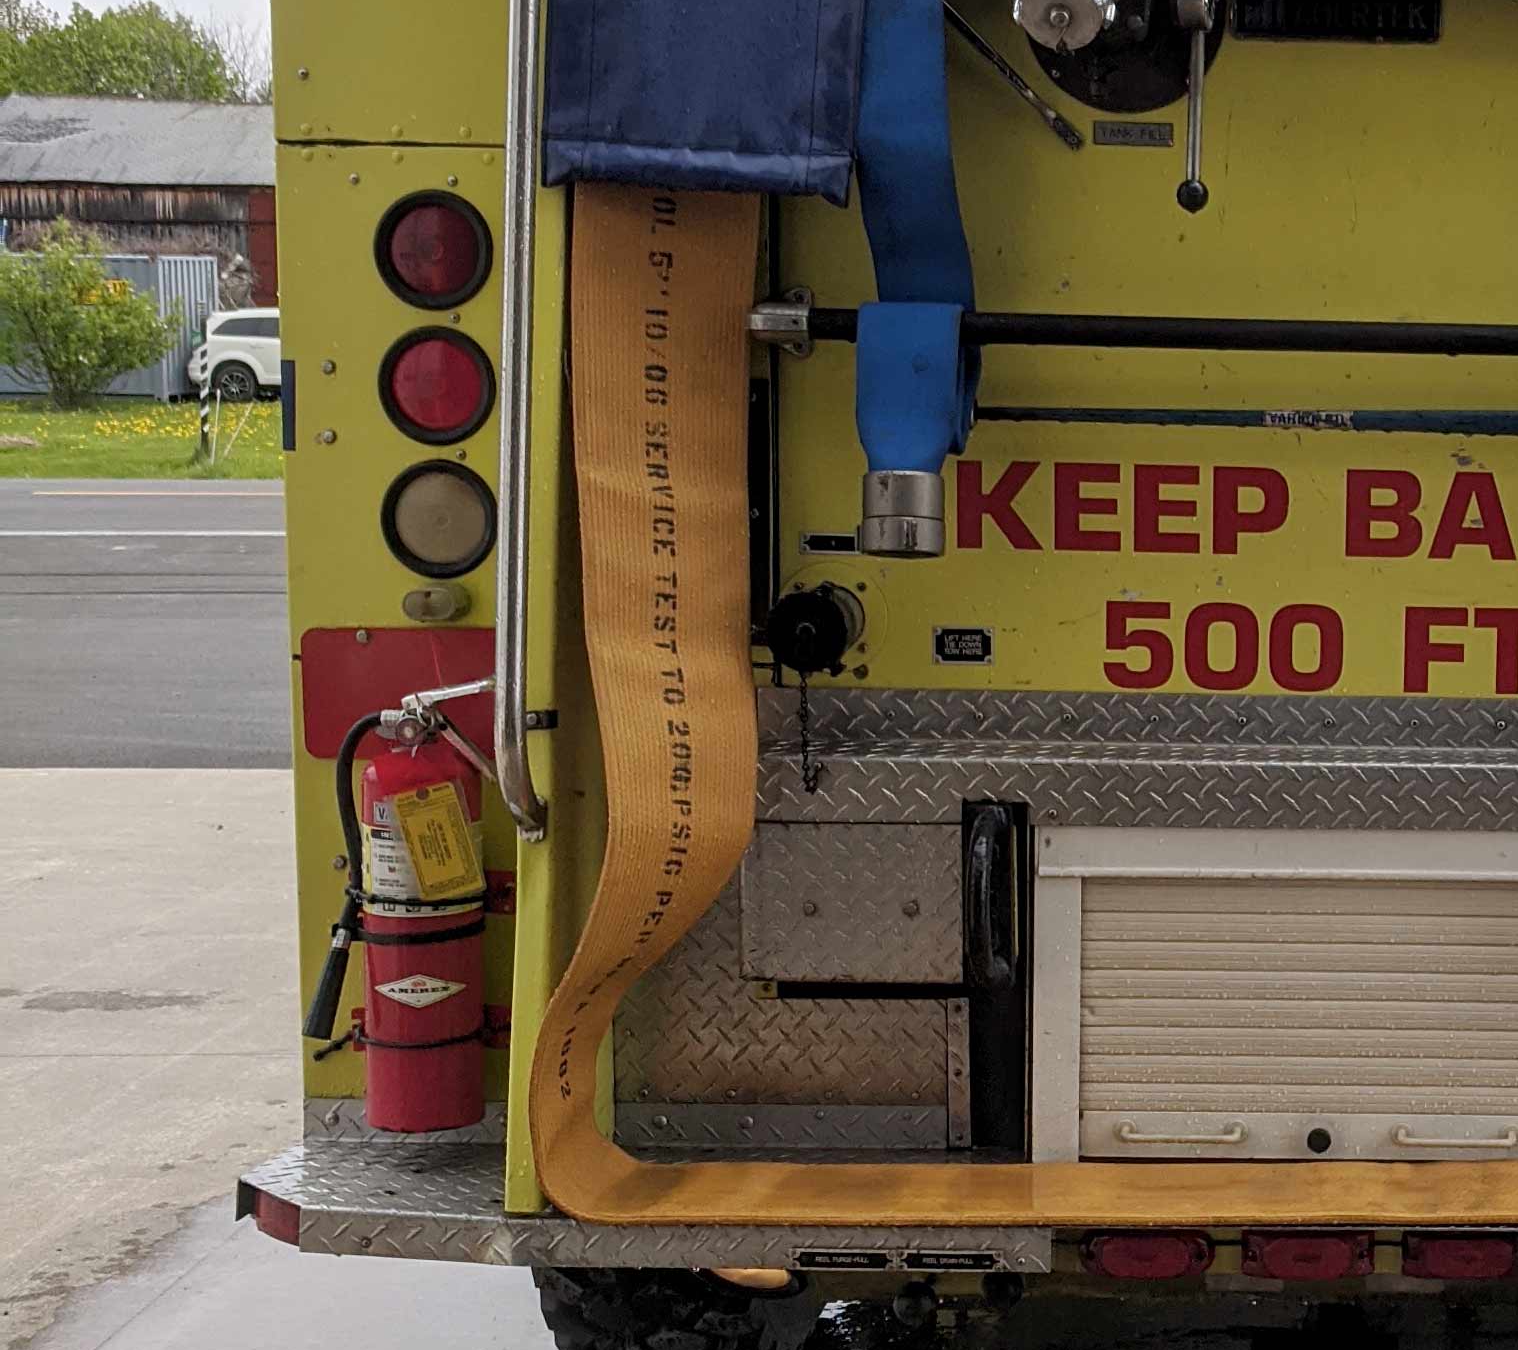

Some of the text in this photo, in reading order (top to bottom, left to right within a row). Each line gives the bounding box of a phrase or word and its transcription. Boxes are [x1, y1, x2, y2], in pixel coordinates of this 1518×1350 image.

[645, 420, 676, 558] SERVICE
[955, 459, 1290, 555] KEEP
[654, 570, 678, 655] TEST
[1103, 600, 1344, 692] 500
[660, 667, 686, 706] TO
